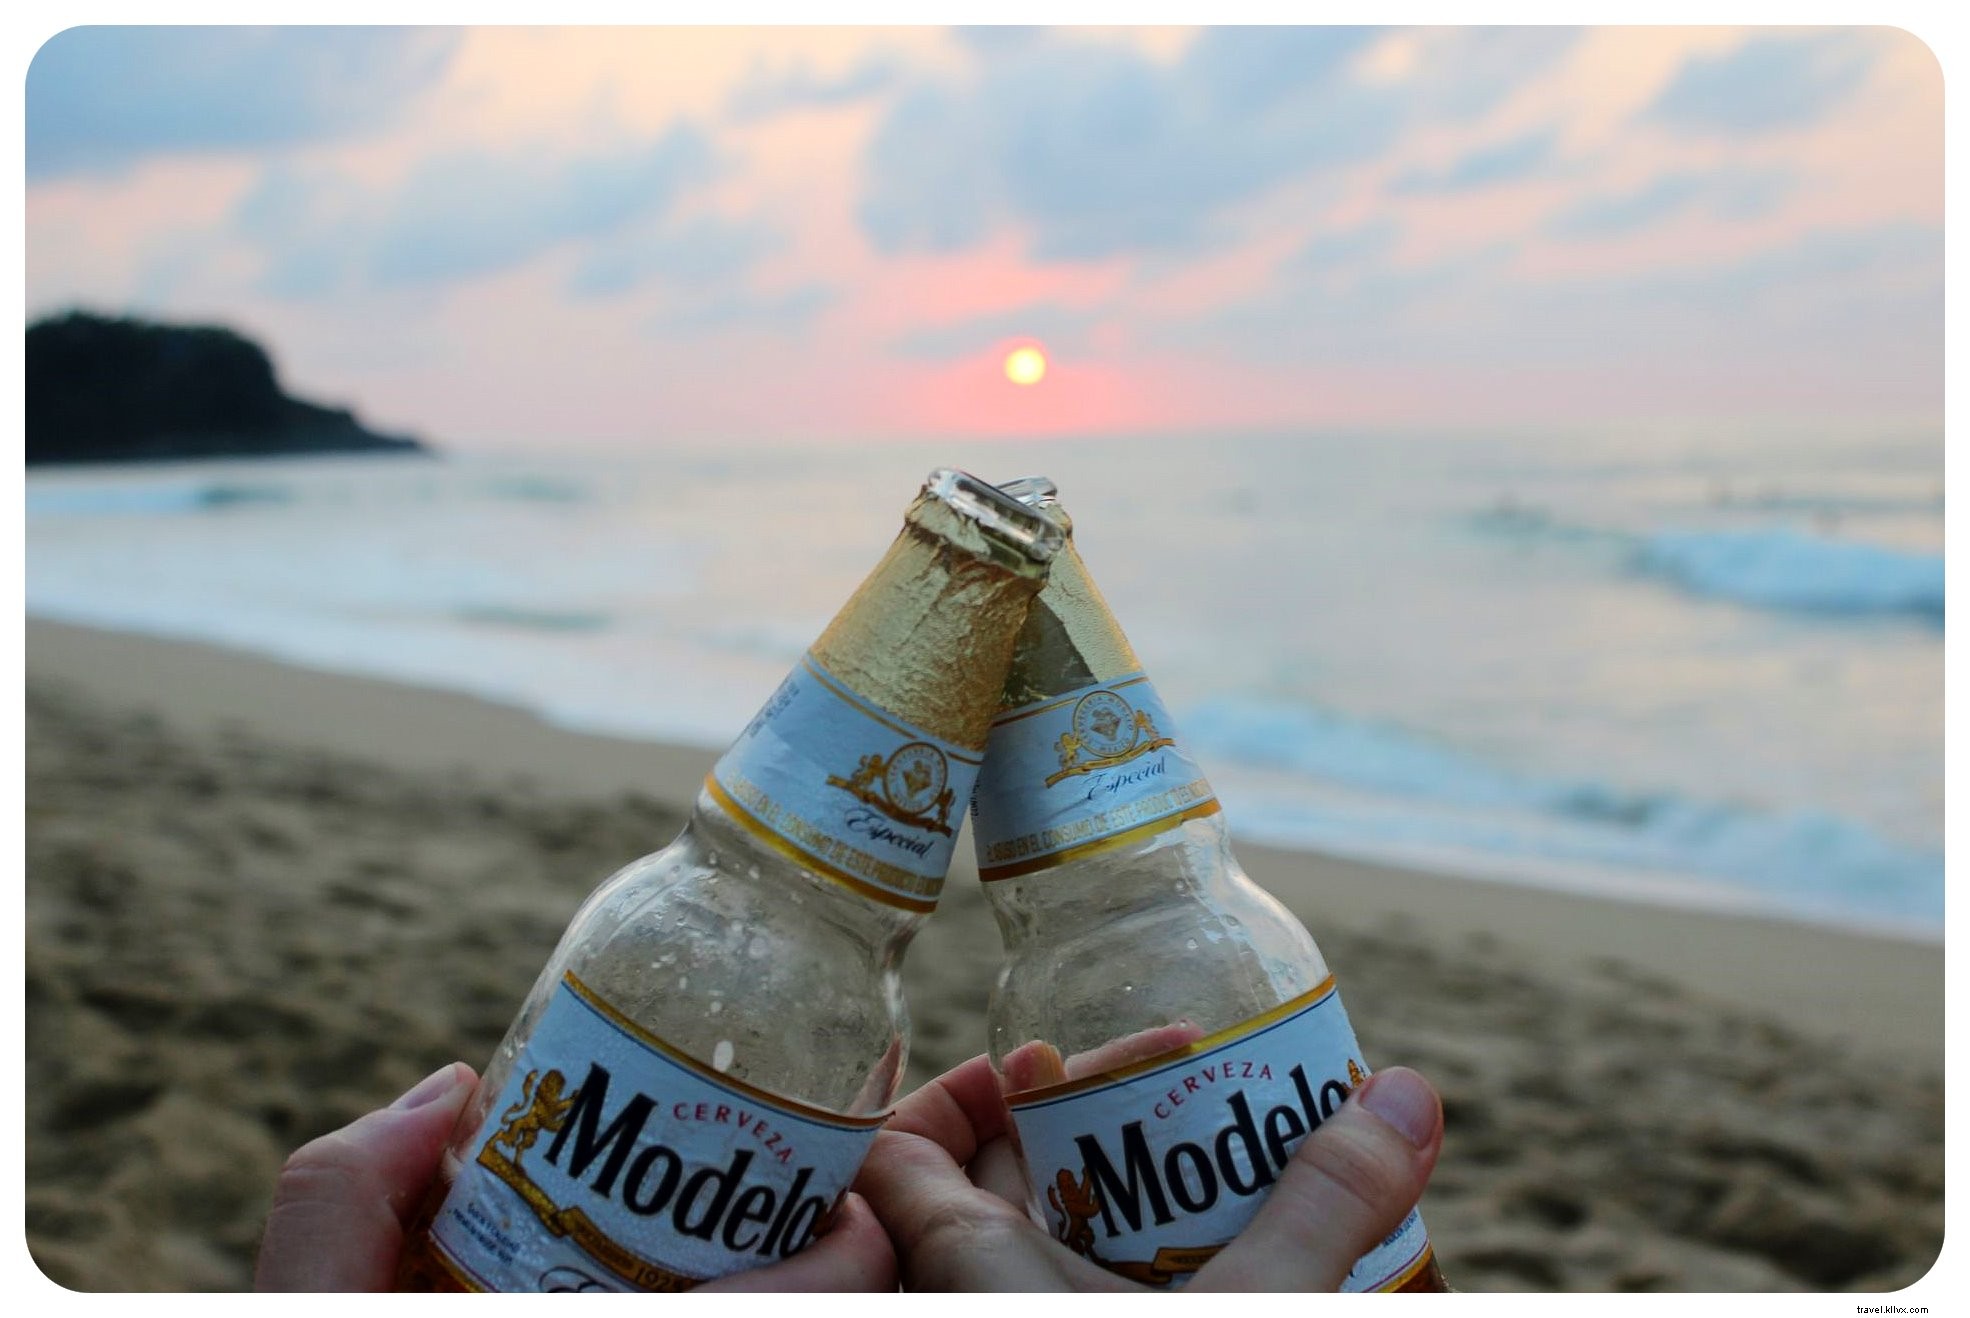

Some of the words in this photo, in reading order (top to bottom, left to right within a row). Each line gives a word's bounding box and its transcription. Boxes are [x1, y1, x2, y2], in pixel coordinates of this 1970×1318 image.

[1081, 756, 1165, 800] Especial
[843, 807, 935, 859] Especial
[1154, 1061, 1273, 1120] CERVEZA
[544, 1060, 826, 1259] Modelo
[672, 1101, 795, 1165] CERVEZA
